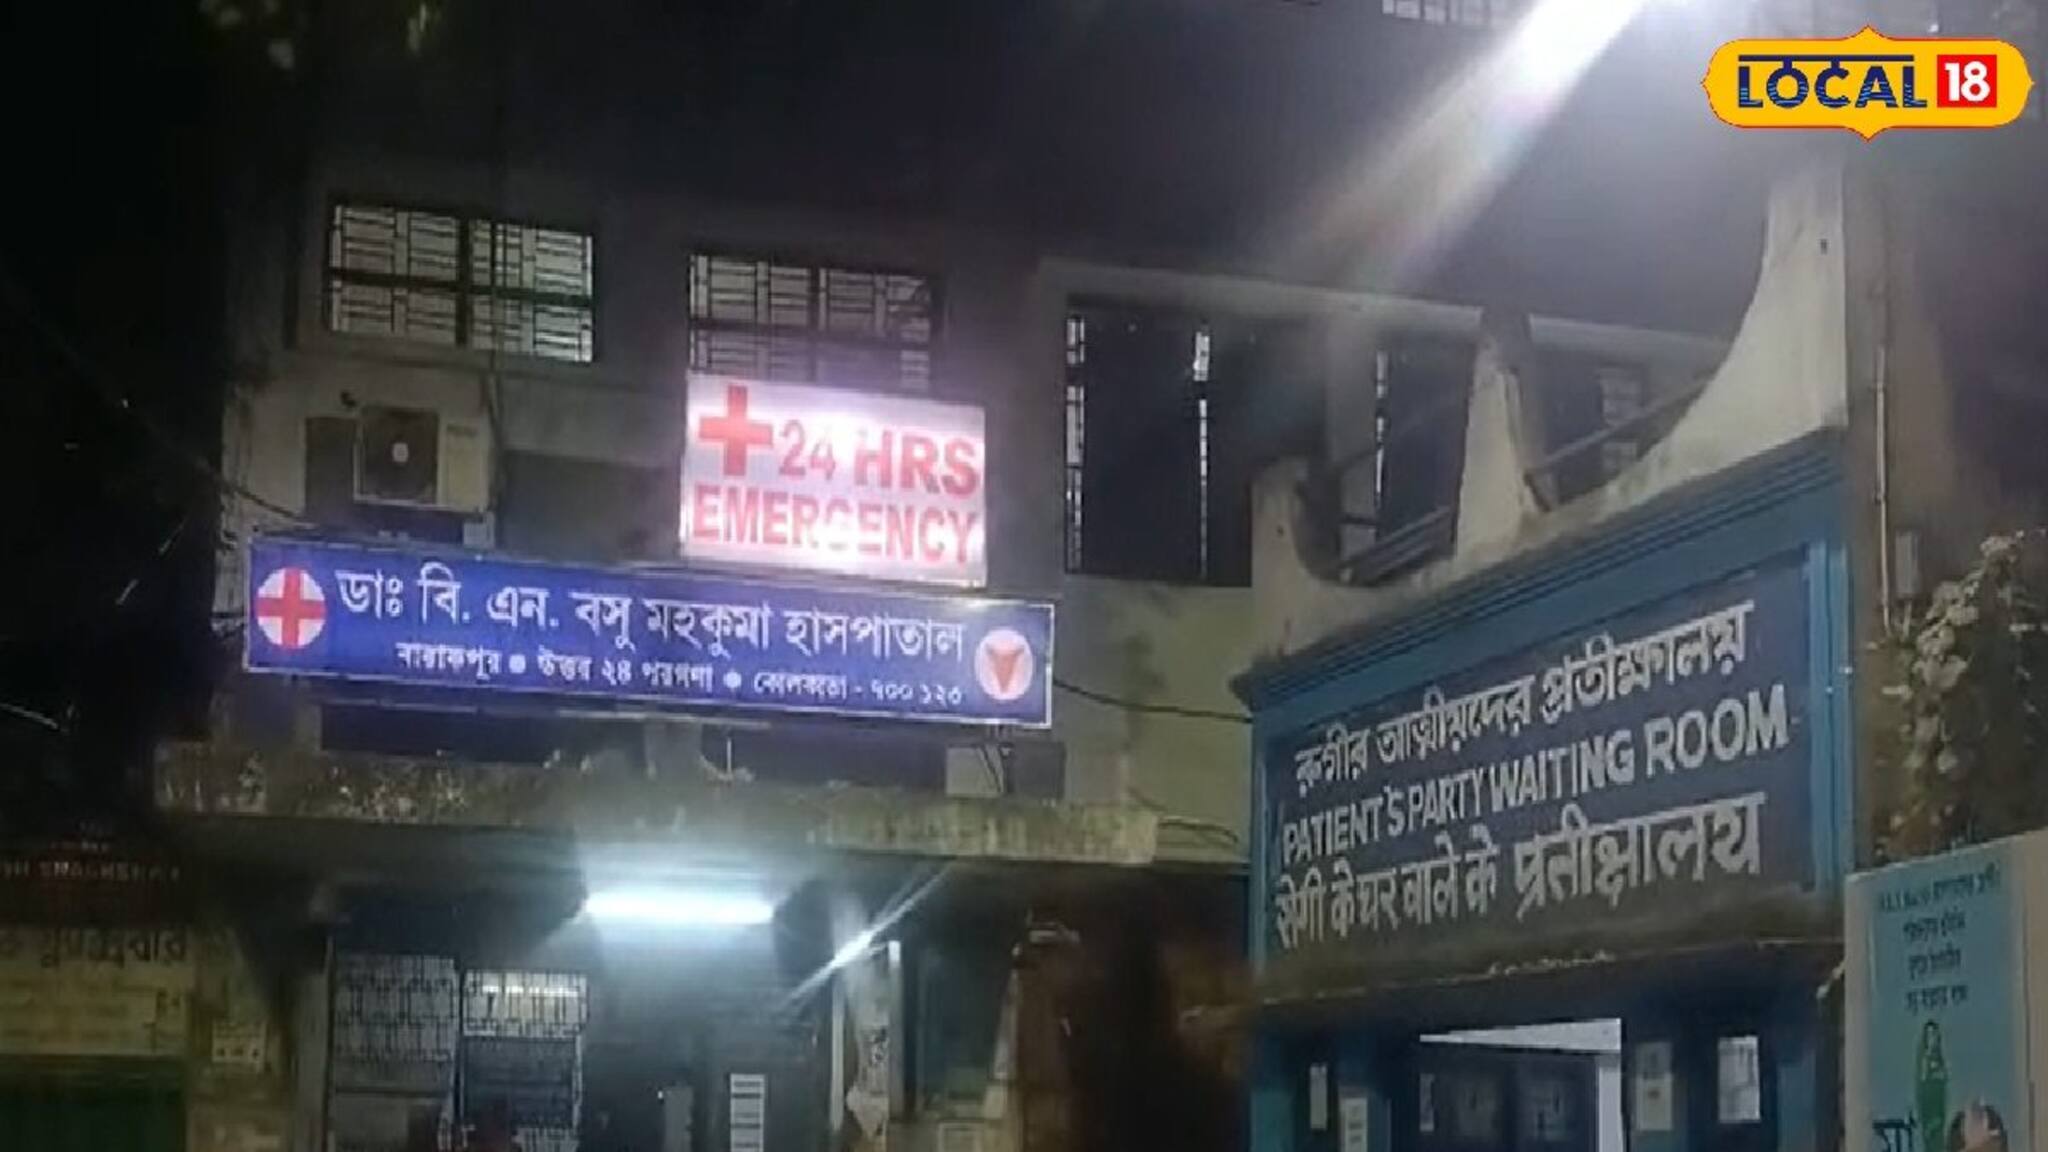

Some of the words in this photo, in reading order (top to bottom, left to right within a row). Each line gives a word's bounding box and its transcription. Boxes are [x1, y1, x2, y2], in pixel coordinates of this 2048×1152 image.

[778, 418, 837, 481] 24
[853, 429, 979, 498] HRS
[692, 484, 978, 565] EMERGENCY
[335, 569, 403, 620] ডাঃ
[417, 562, 470, 623] বি.
[486, 586, 559, 629] এন.
[568, 591, 636, 650] বসু
[646, 600, 773, 660] মহকুমা
[782, 607, 965, 664] হাসপাতাল
[537, 644, 592, 682] উত্তর
[601, 658, 631, 686] ২৪
[1406, 766, 1484, 833] PARTY
[1488, 729, 1637, 813] WAITING
[1643, 683, 1789, 778] ROOM
